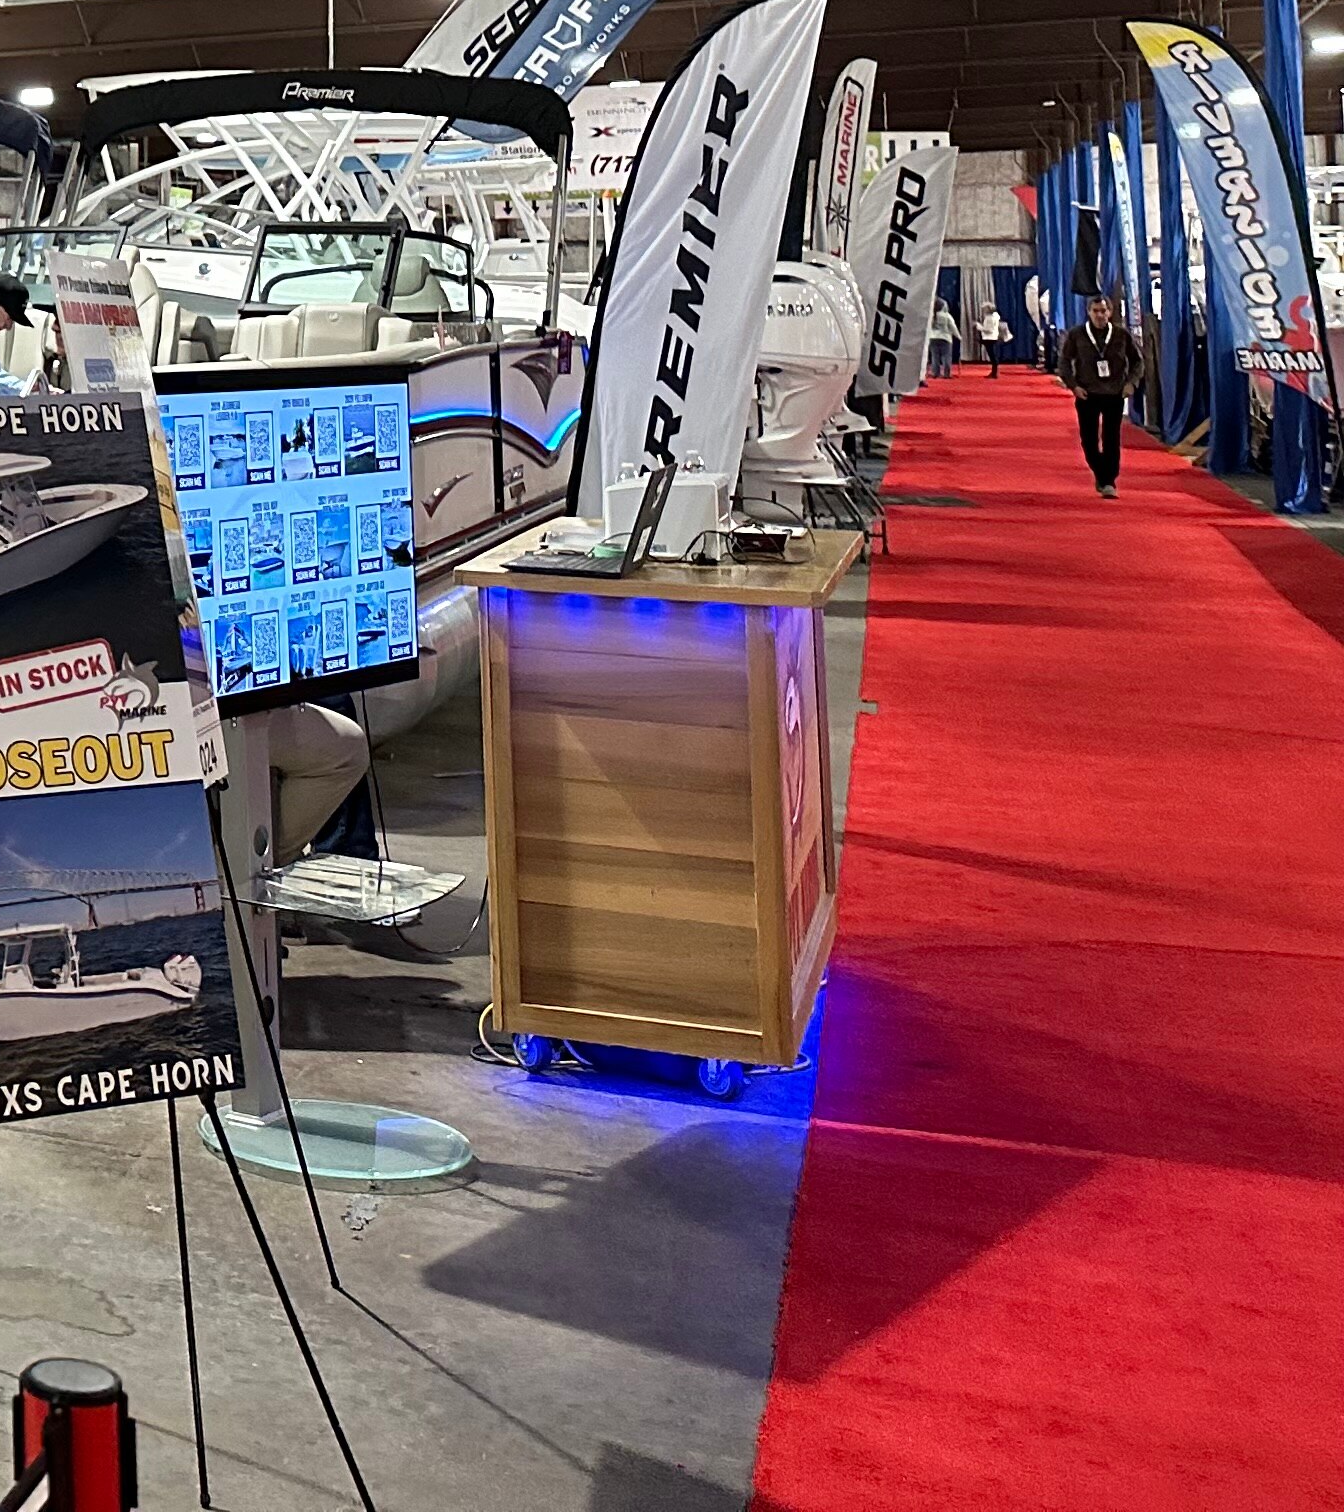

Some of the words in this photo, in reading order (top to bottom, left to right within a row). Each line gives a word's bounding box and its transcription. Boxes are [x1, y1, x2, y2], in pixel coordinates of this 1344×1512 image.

[586, 4, 632, 54] WORKS
[837, 90, 858, 186] MARINE
[884, 166, 931, 276] PRO
[640, 72, 749, 477] REMIER
[868, 279, 908, 389] SEA
[40, 402, 125, 434] HORN
[28, 654, 108, 691] STOCK
[119, 704, 168, 720] MARINE
[198, 737, 218, 777] 024
[56, 1067, 136, 1107] CAPE
[149, 1053, 235, 1095] HORN
